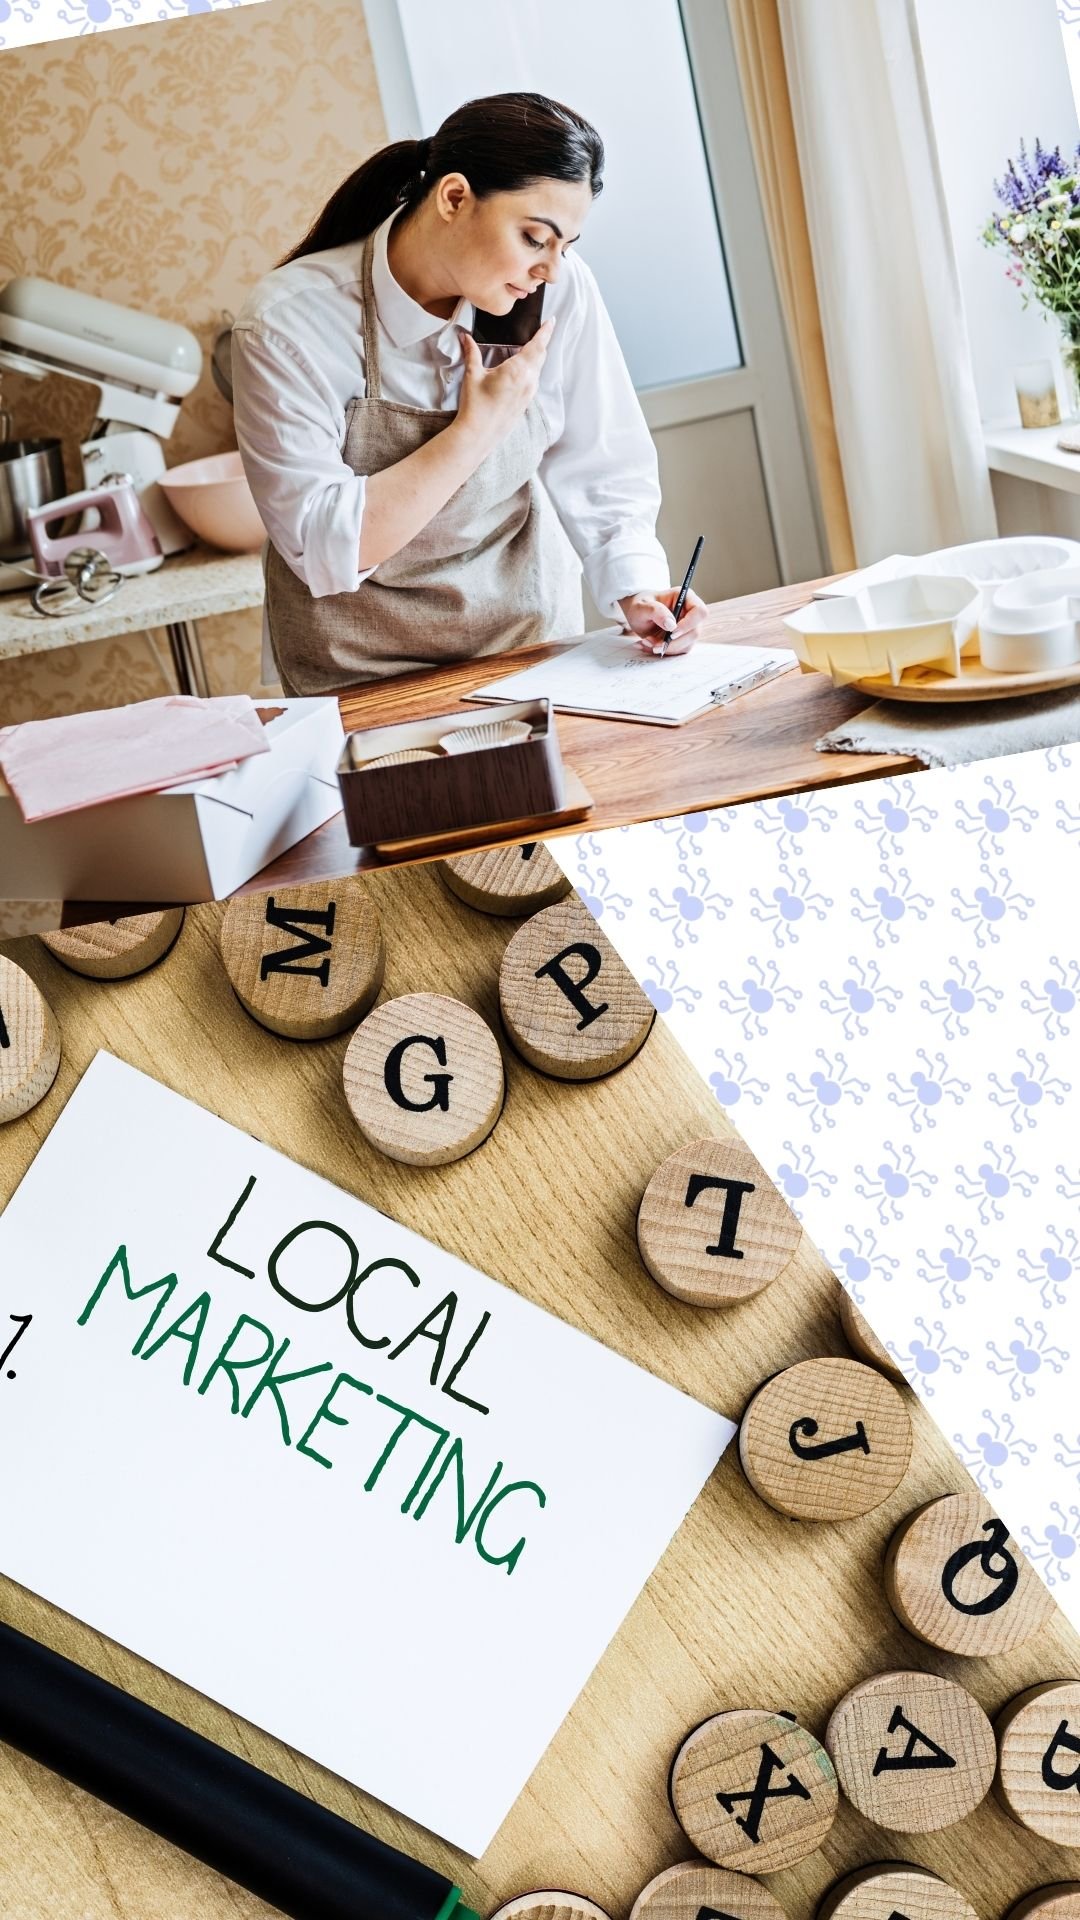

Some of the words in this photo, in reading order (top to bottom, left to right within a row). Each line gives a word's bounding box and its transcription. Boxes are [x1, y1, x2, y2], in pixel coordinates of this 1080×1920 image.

[260, 896, 337, 988] M
[534, 942, 609, 1032] P
[384, 1034, 454, 1113] G
[206, 1175, 491, 1416] LOCAL
[76, 1244, 547, 1575] MARKETING
[788, 1417, 871, 1461] J
[941, 1518, 1019, 1616] Q
[872, 1705, 957, 1777] A
[715, 1742, 812, 1844] X
